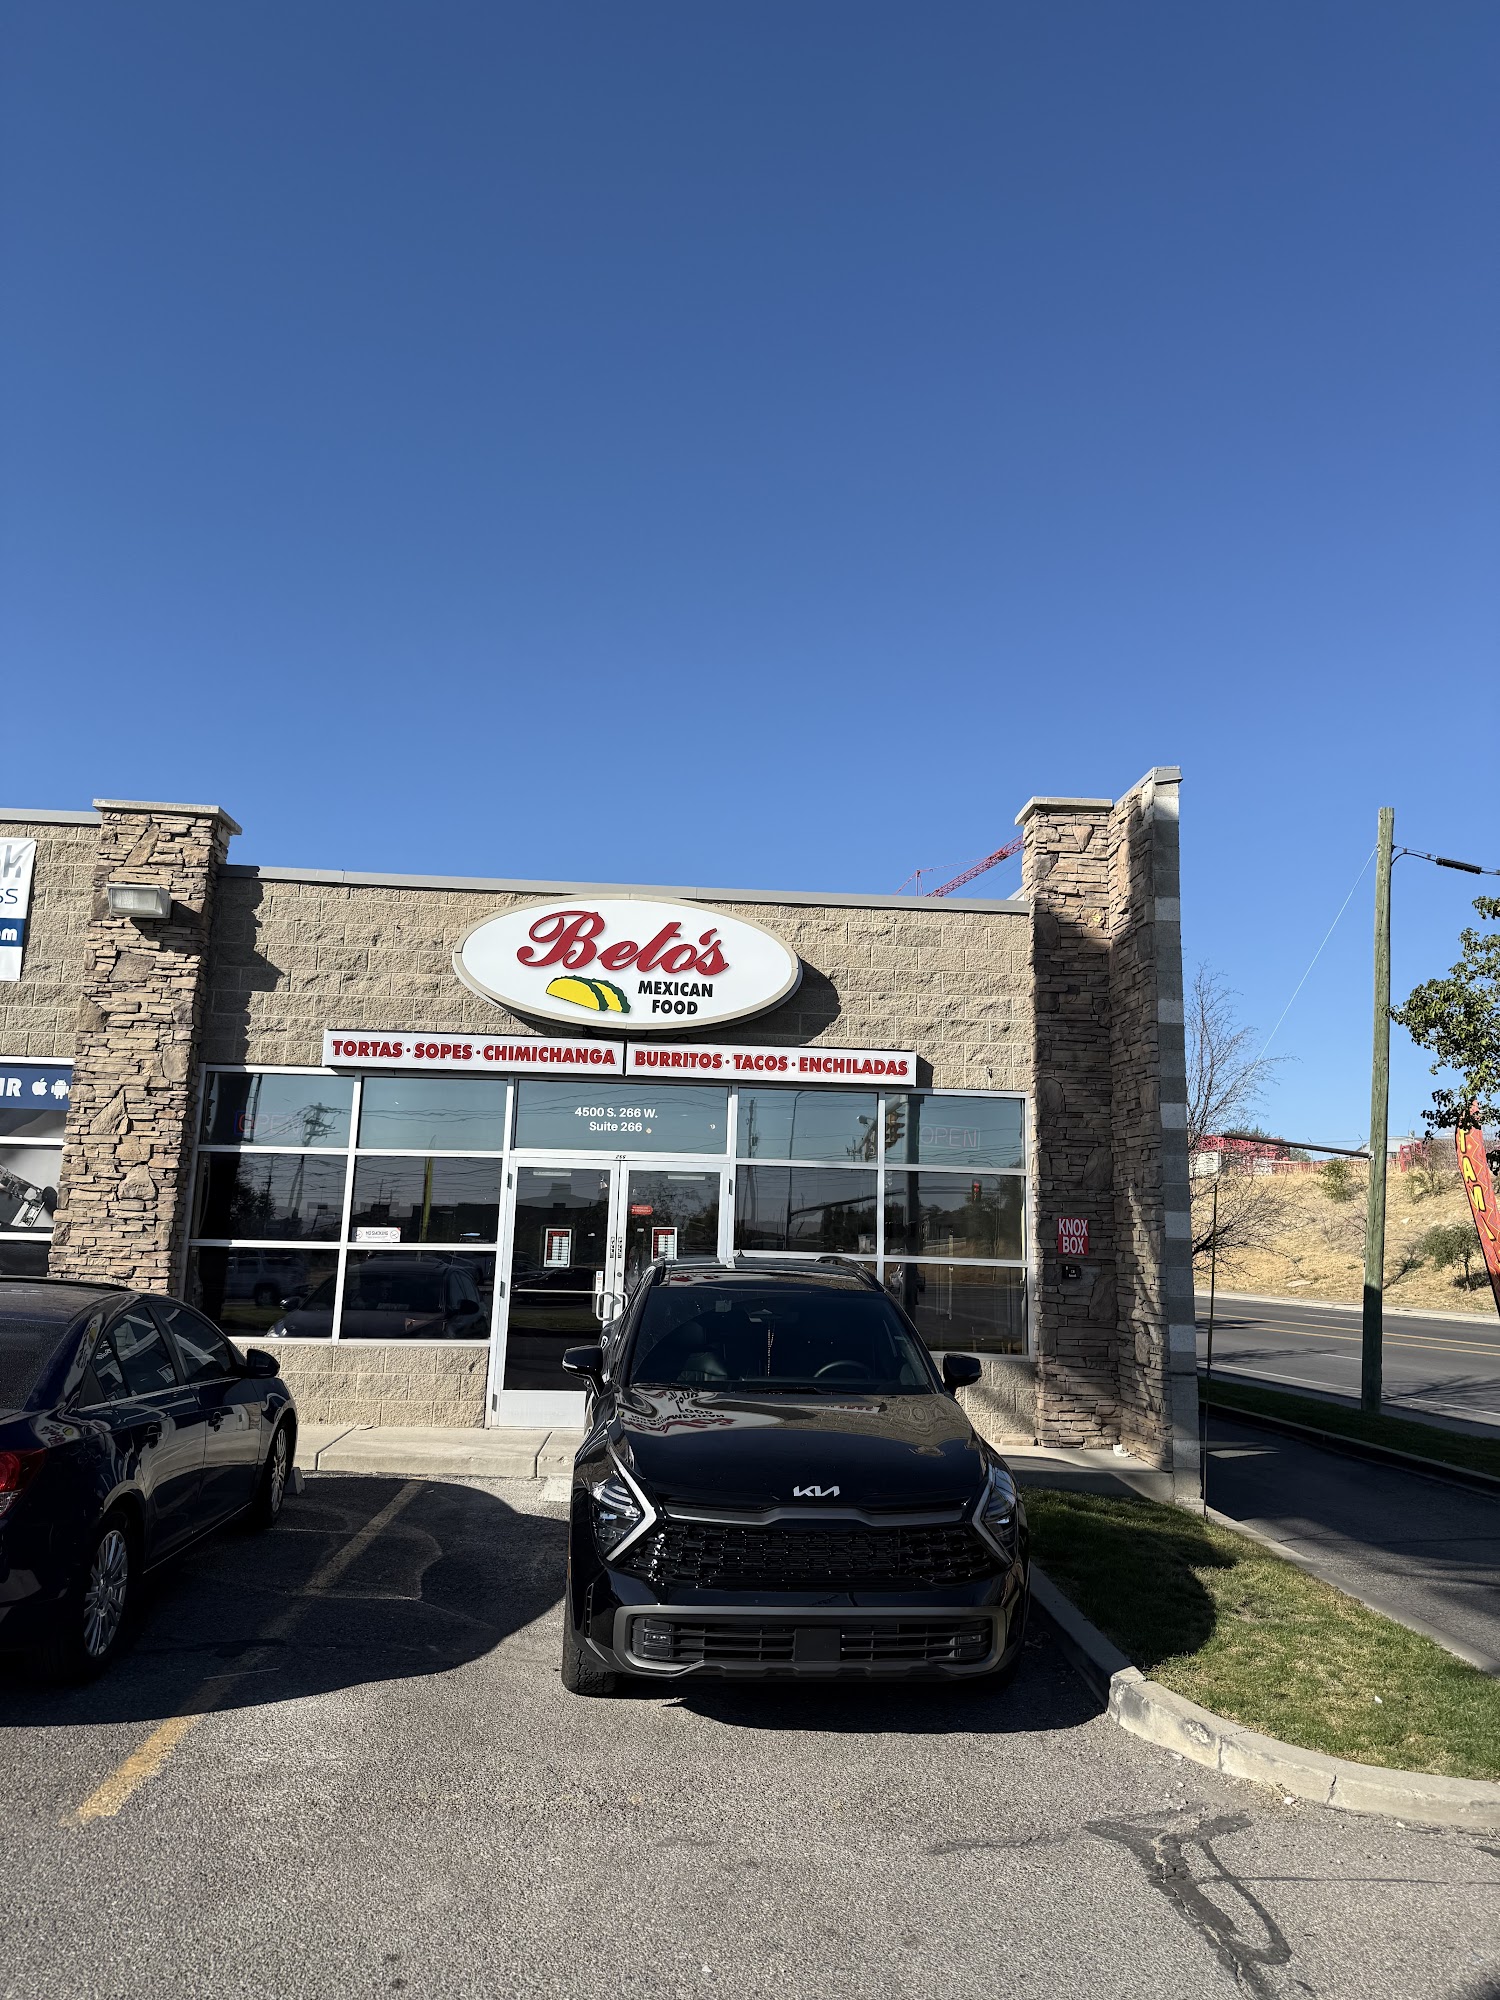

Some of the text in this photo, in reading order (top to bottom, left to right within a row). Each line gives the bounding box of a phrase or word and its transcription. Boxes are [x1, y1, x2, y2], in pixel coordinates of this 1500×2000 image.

[516, 910, 730, 976] Beto's
[637, 980, 714, 997] MEXICAN
[651, 999, 698, 1015] FOOD
[332, 1040, 616, 1065] TORTAS SOPES CHIMICHANGA
[634, 1050, 909, 1077] BURRITOS TACOS ENCHILADAS
[574, 1107, 658, 1119] 4500 S. 266 W.
[589, 1121, 643, 1132] Suite 266
[920, 1126, 977, 1148] OPEN
[1058, 1218, 1088, 1236] KNOX
[1062, 1236, 1085, 1254] BOX
